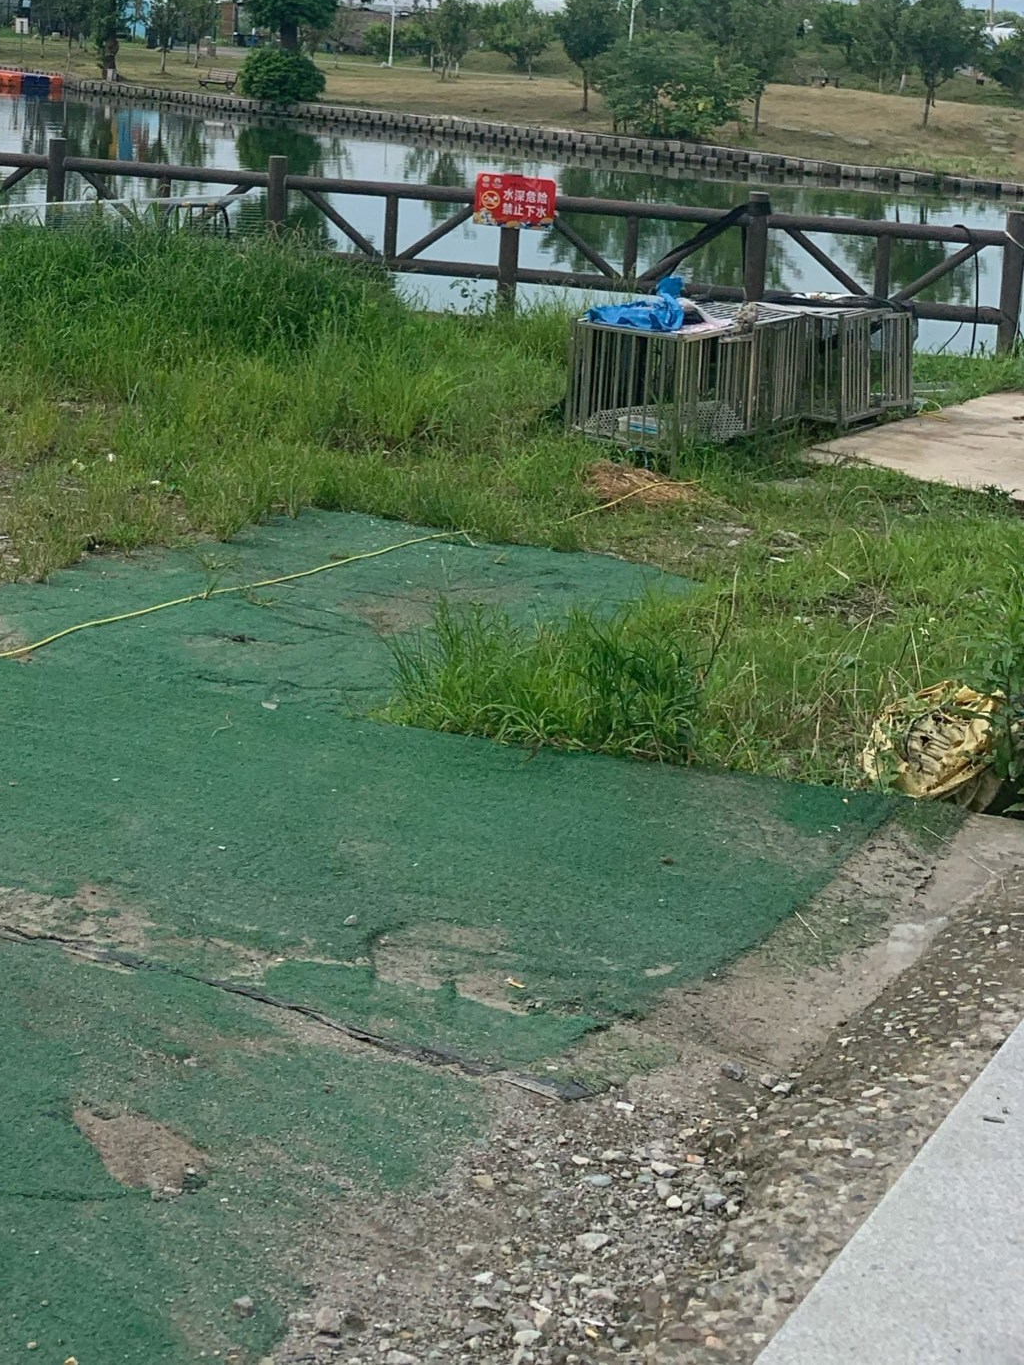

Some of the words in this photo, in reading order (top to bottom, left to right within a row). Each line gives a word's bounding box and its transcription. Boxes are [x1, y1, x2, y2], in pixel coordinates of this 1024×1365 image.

[503, 189, 548, 204] 水深危险
[502, 202, 547, 218] 禁止下水
